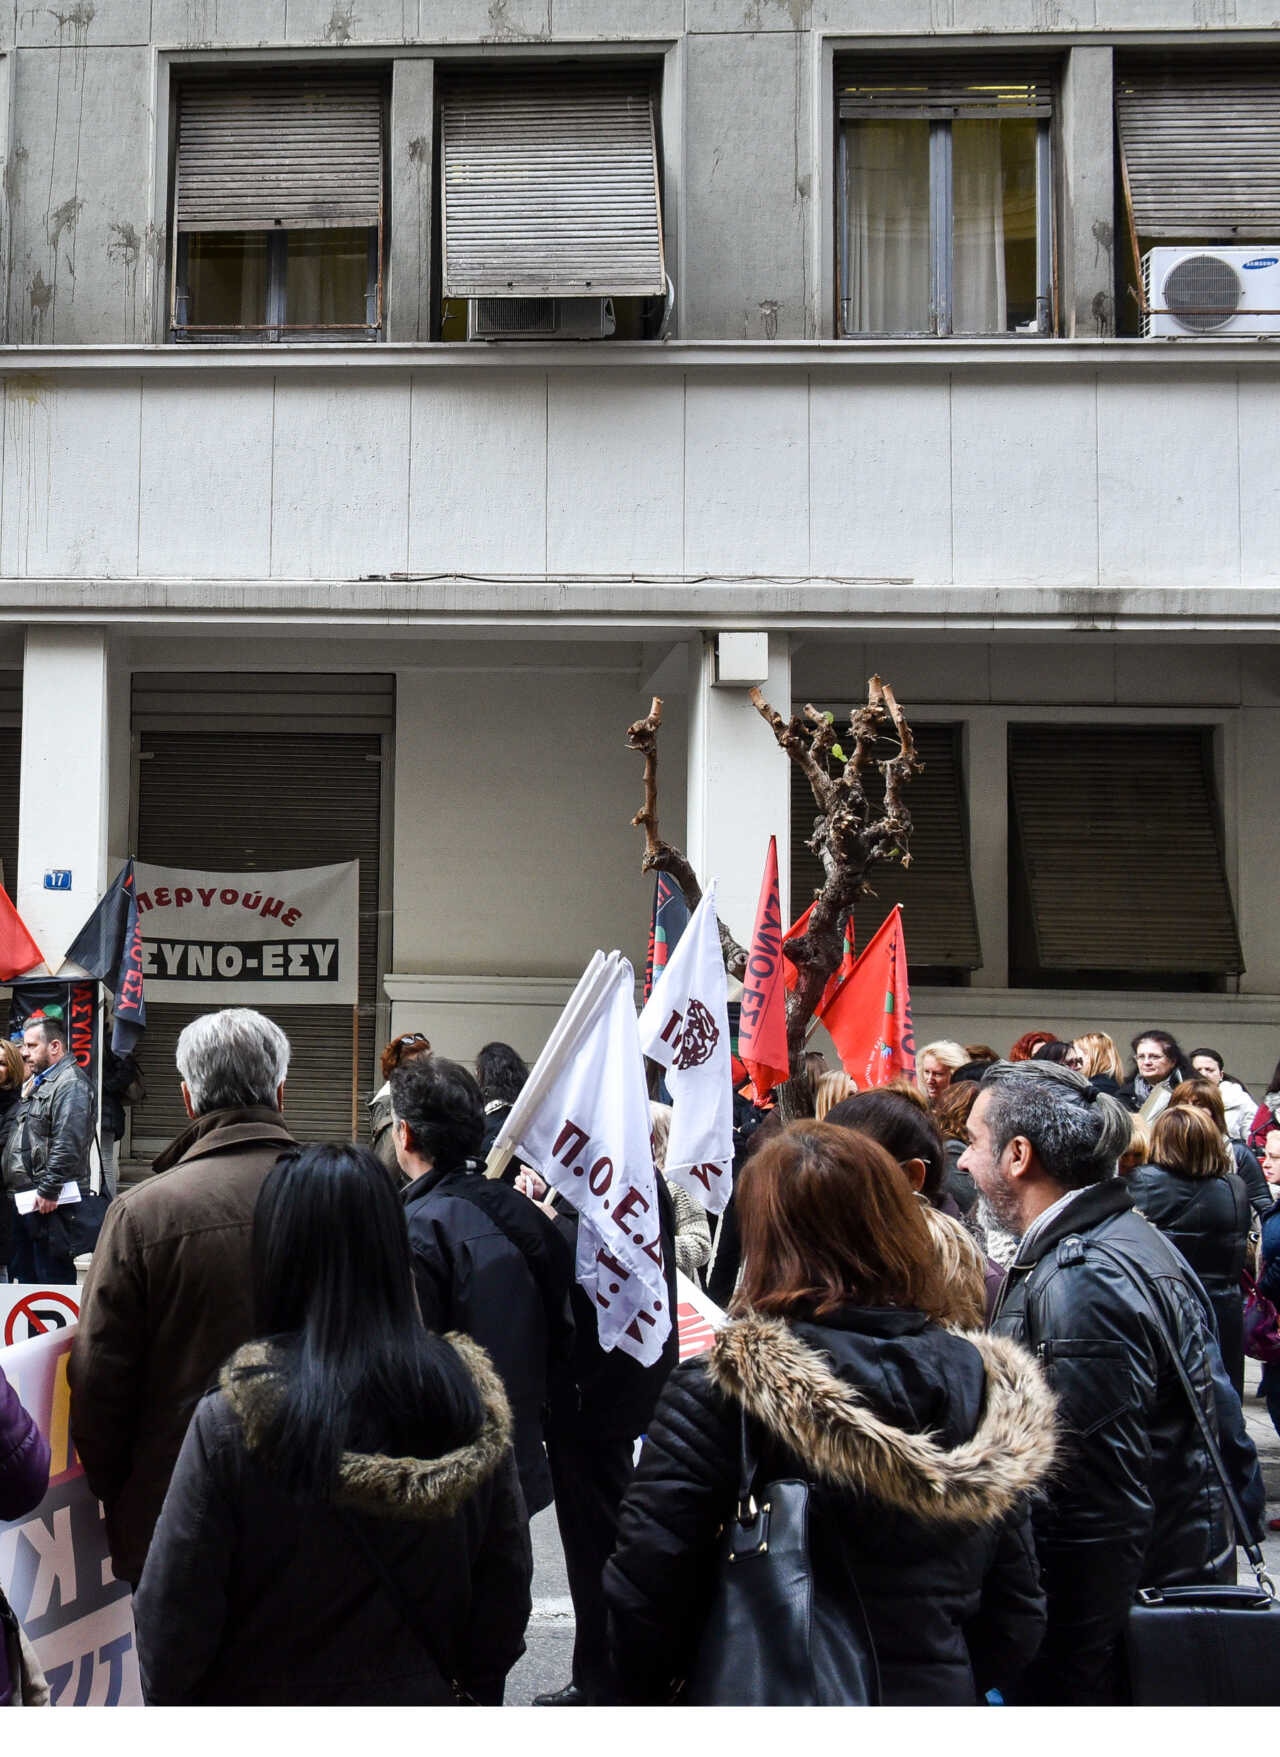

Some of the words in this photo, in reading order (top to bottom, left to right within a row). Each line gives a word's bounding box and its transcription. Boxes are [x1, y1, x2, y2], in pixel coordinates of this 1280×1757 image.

[51, 873, 64, 886] 17
[137, 887, 303, 928] περγούμε
[141, 943, 336, 978] ΣΥΝΟ-ΕΣΥ
